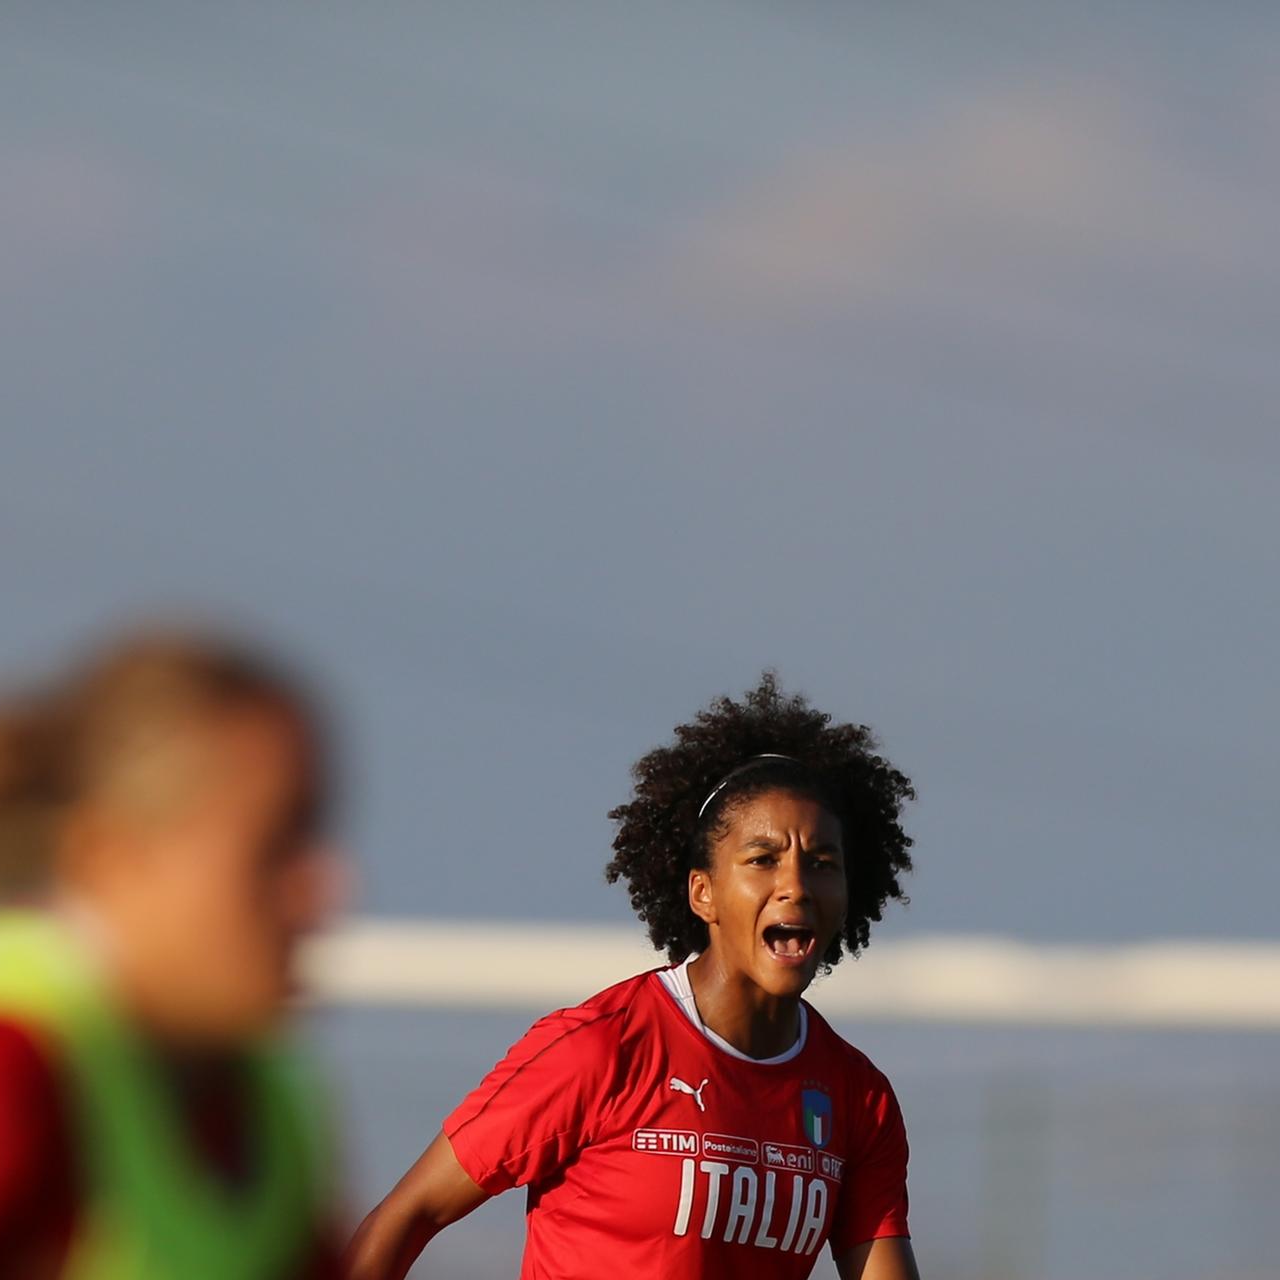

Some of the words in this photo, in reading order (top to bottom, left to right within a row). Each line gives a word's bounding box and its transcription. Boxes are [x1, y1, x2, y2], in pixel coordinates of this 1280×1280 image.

[659, 1133, 695, 1152] TIM
[789, 1151, 812, 1169] eni
[673, 1158, 828, 1256] ITALIA
